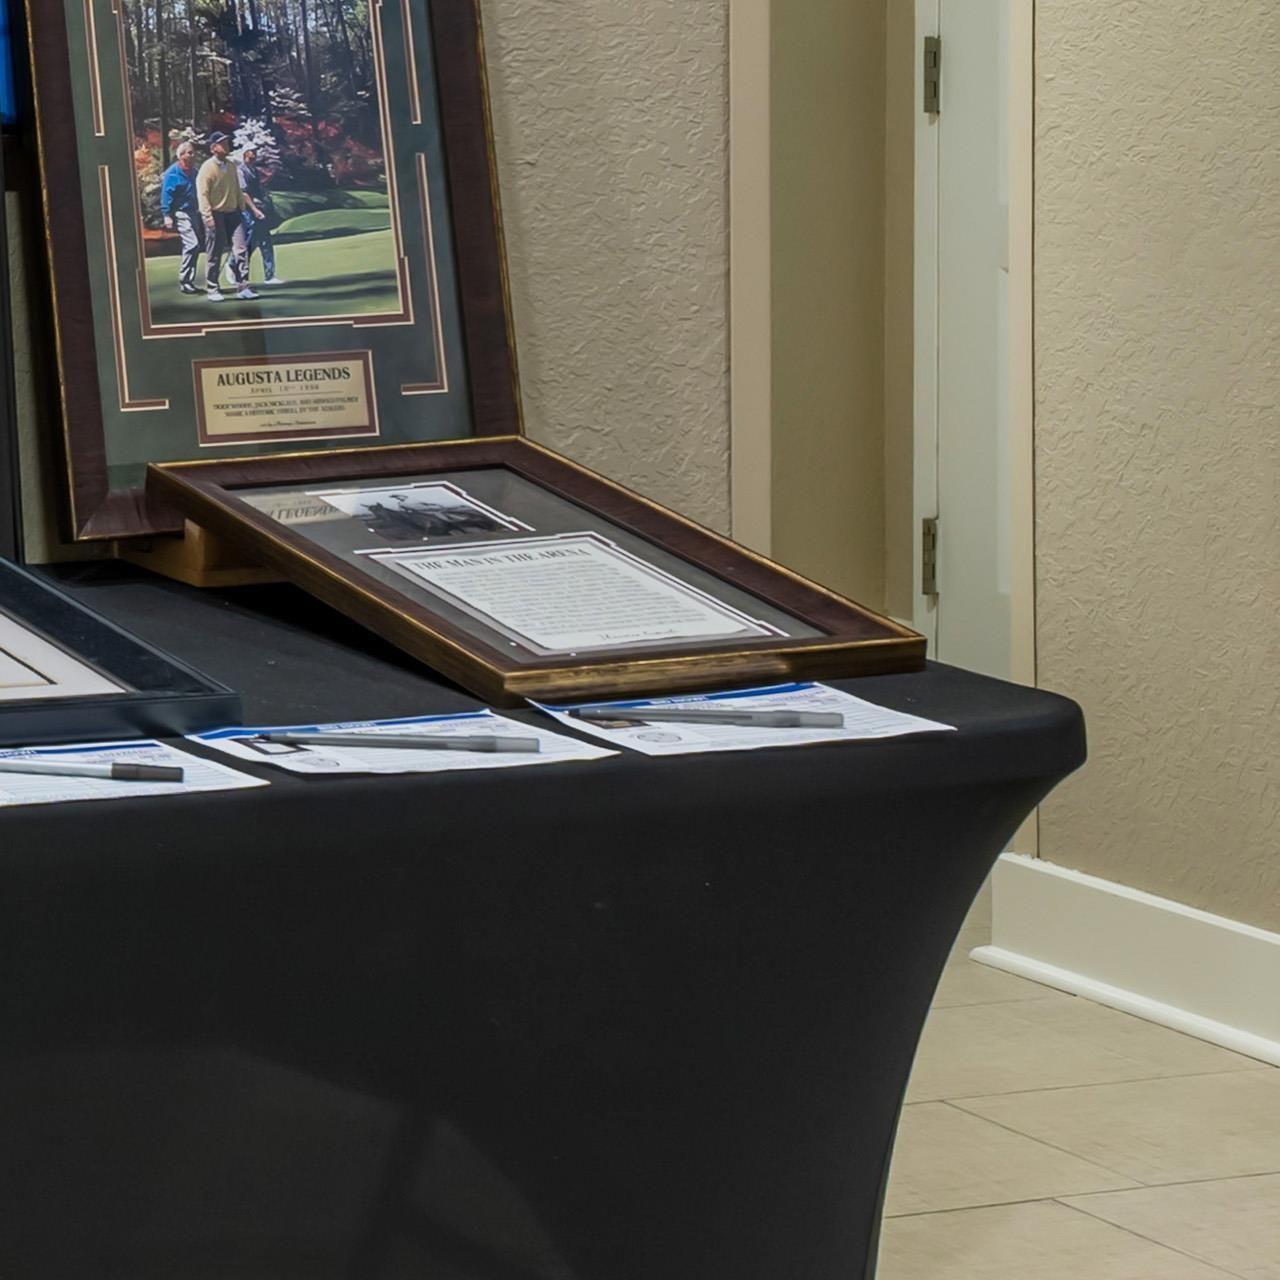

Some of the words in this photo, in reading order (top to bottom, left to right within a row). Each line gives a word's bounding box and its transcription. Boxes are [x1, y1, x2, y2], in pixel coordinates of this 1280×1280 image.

[216, 370, 283, 387] AUGUSTA
[286, 367, 351, 382] LEGENDS
[413, 561, 446, 571] THE
[447, 558, 482, 568] MAN
[482, 557, 502, 565] IN
[504, 553, 538, 563] THE
[539, 548, 591, 560] ARENA
